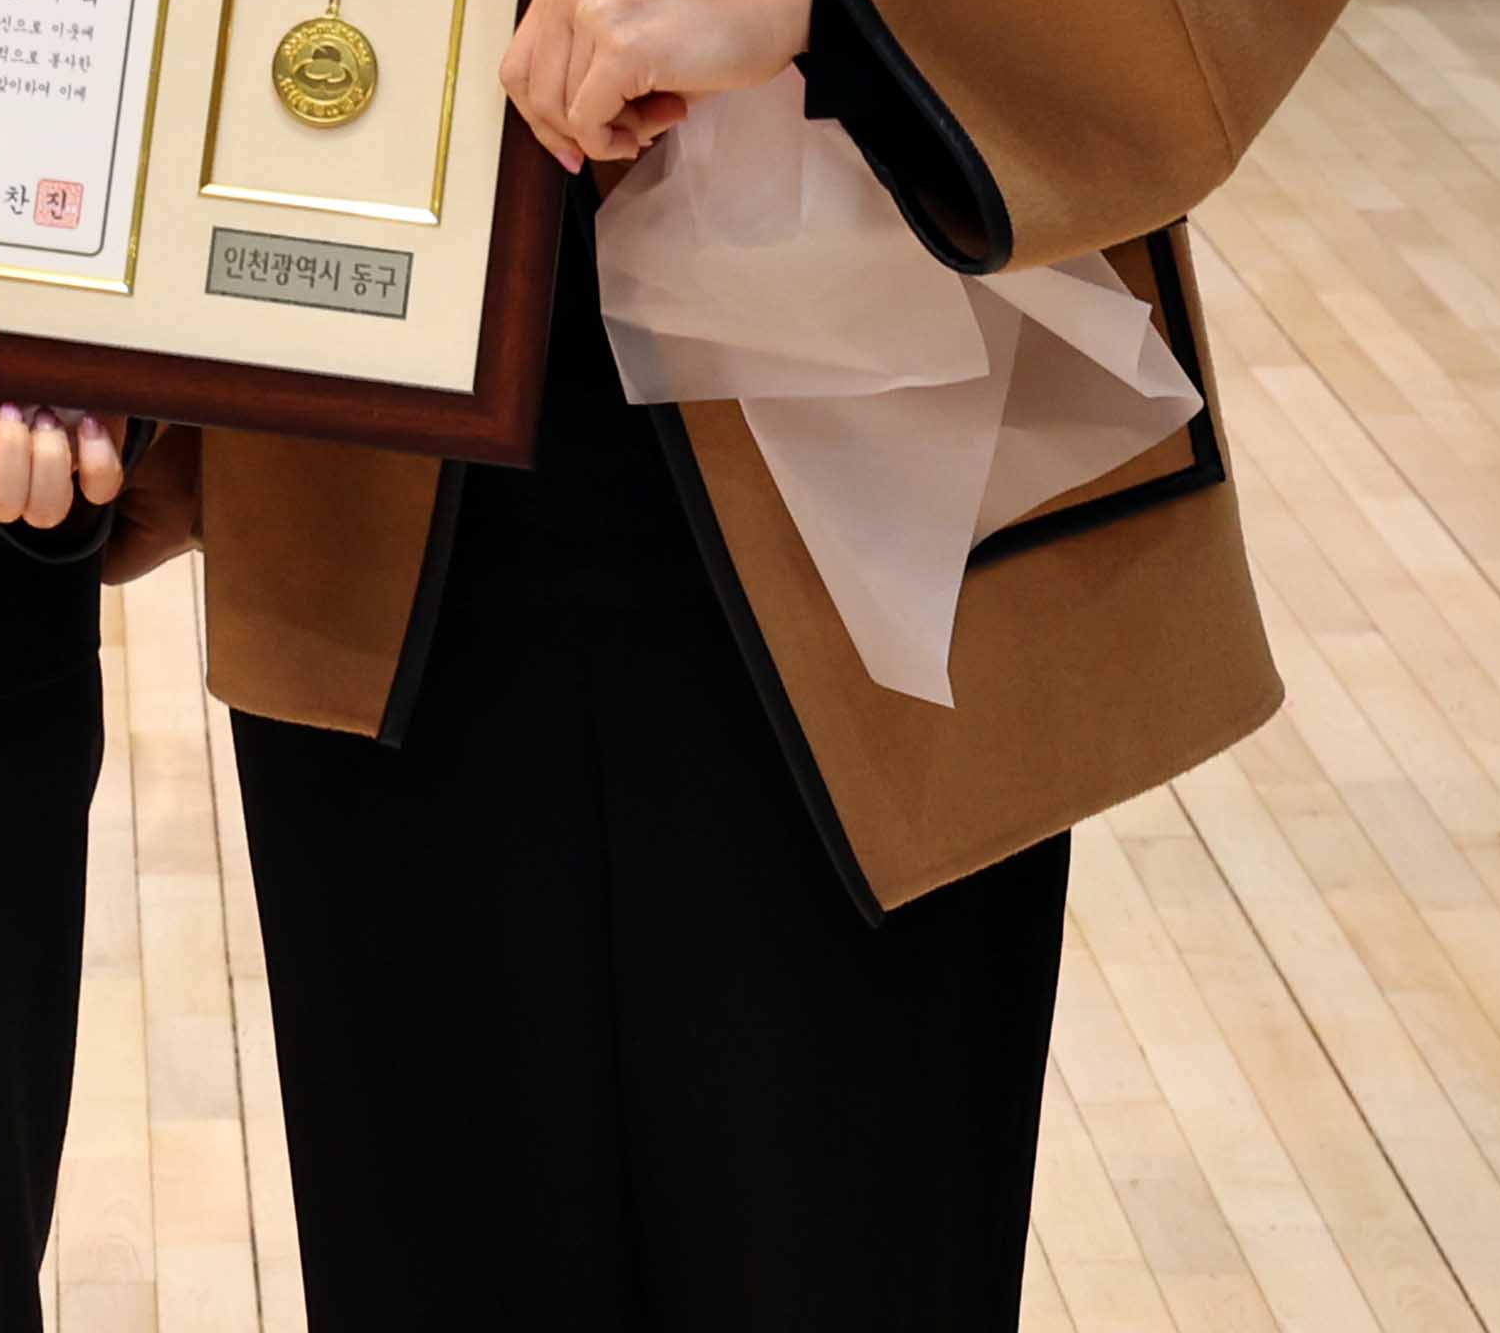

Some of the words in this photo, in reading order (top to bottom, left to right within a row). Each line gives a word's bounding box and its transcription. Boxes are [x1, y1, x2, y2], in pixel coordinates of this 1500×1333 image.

[51, 22, 94, 41] 이웃에
[48, 53, 92, 73] 봉사한
[59, 84, 88, 102] 이에
[223, 247, 342, 292] 인천광역시
[351, 262, 397, 298] 동구
